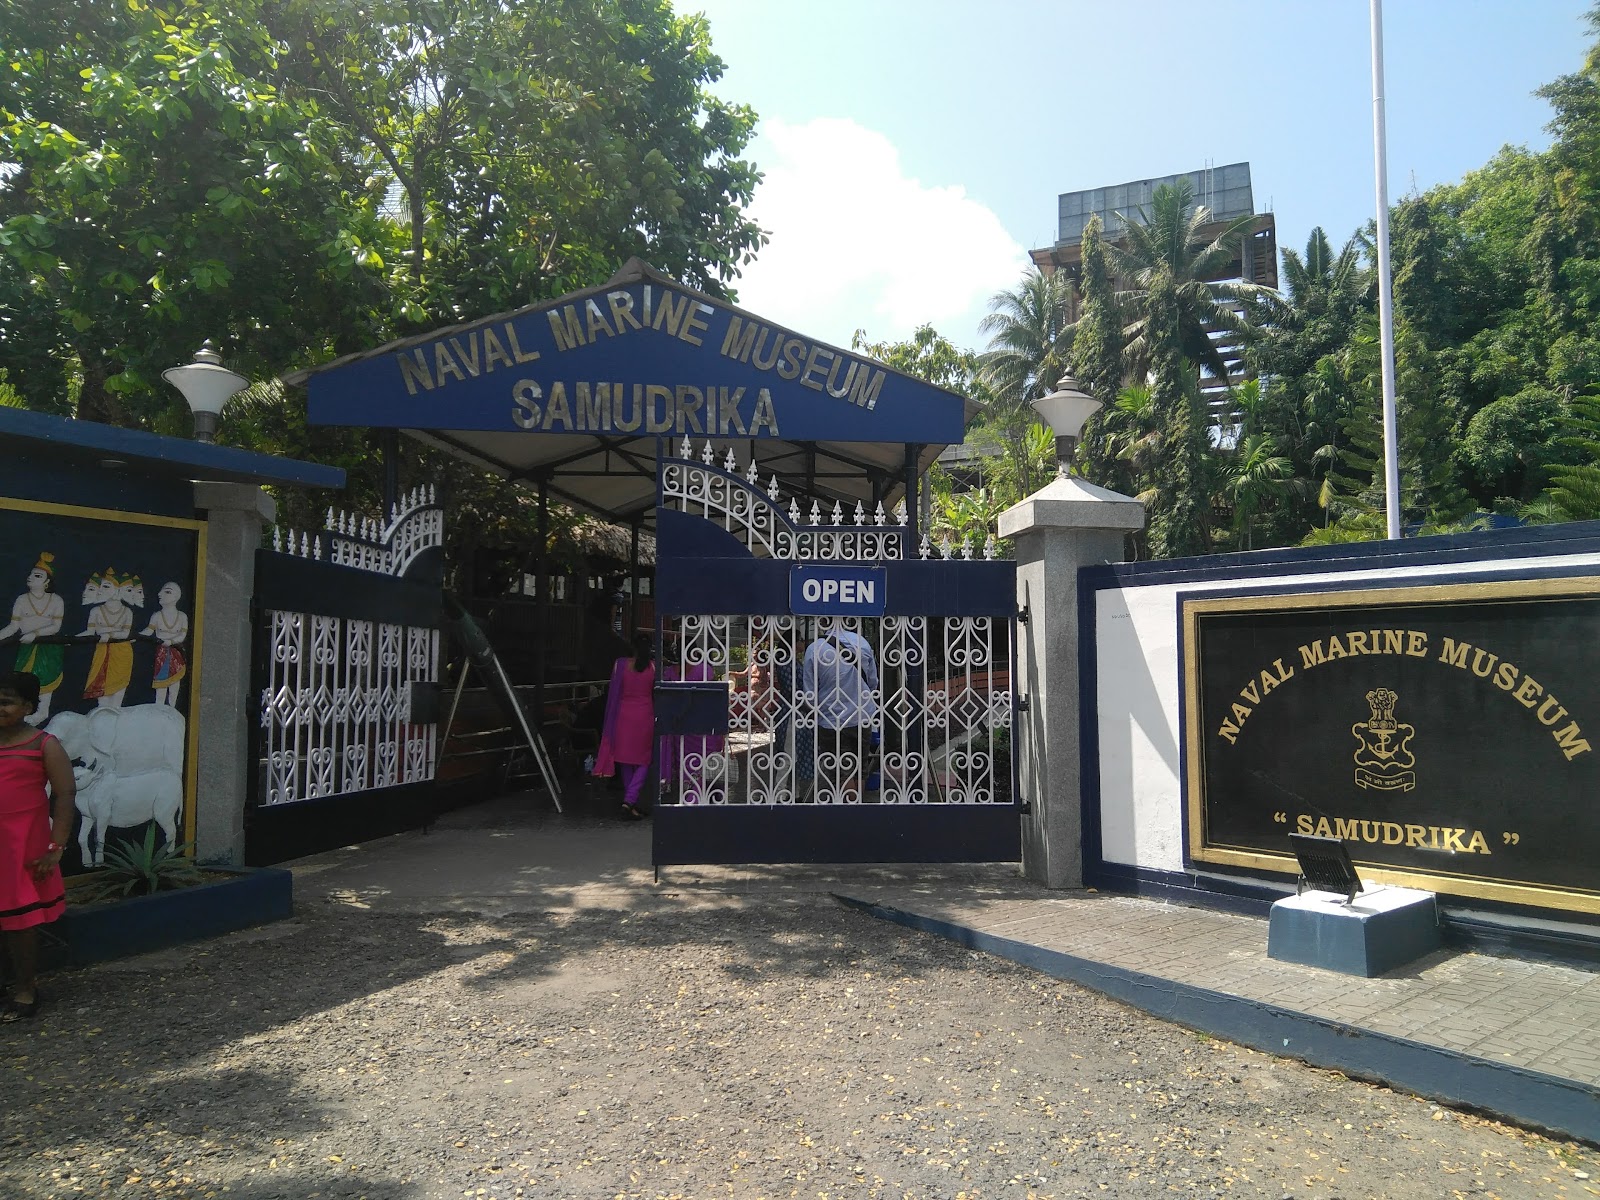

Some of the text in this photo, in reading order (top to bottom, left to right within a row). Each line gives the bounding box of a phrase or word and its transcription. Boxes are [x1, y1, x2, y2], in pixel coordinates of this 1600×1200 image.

[398, 284, 887, 411] NAVAL MARINE MUSEUM
[511, 378, 780, 437] SAMUDRIKA
[802, 579, 875, 604] OPEN
[1217, 629, 1592, 762] NAVAL MARINE MUSEUM
